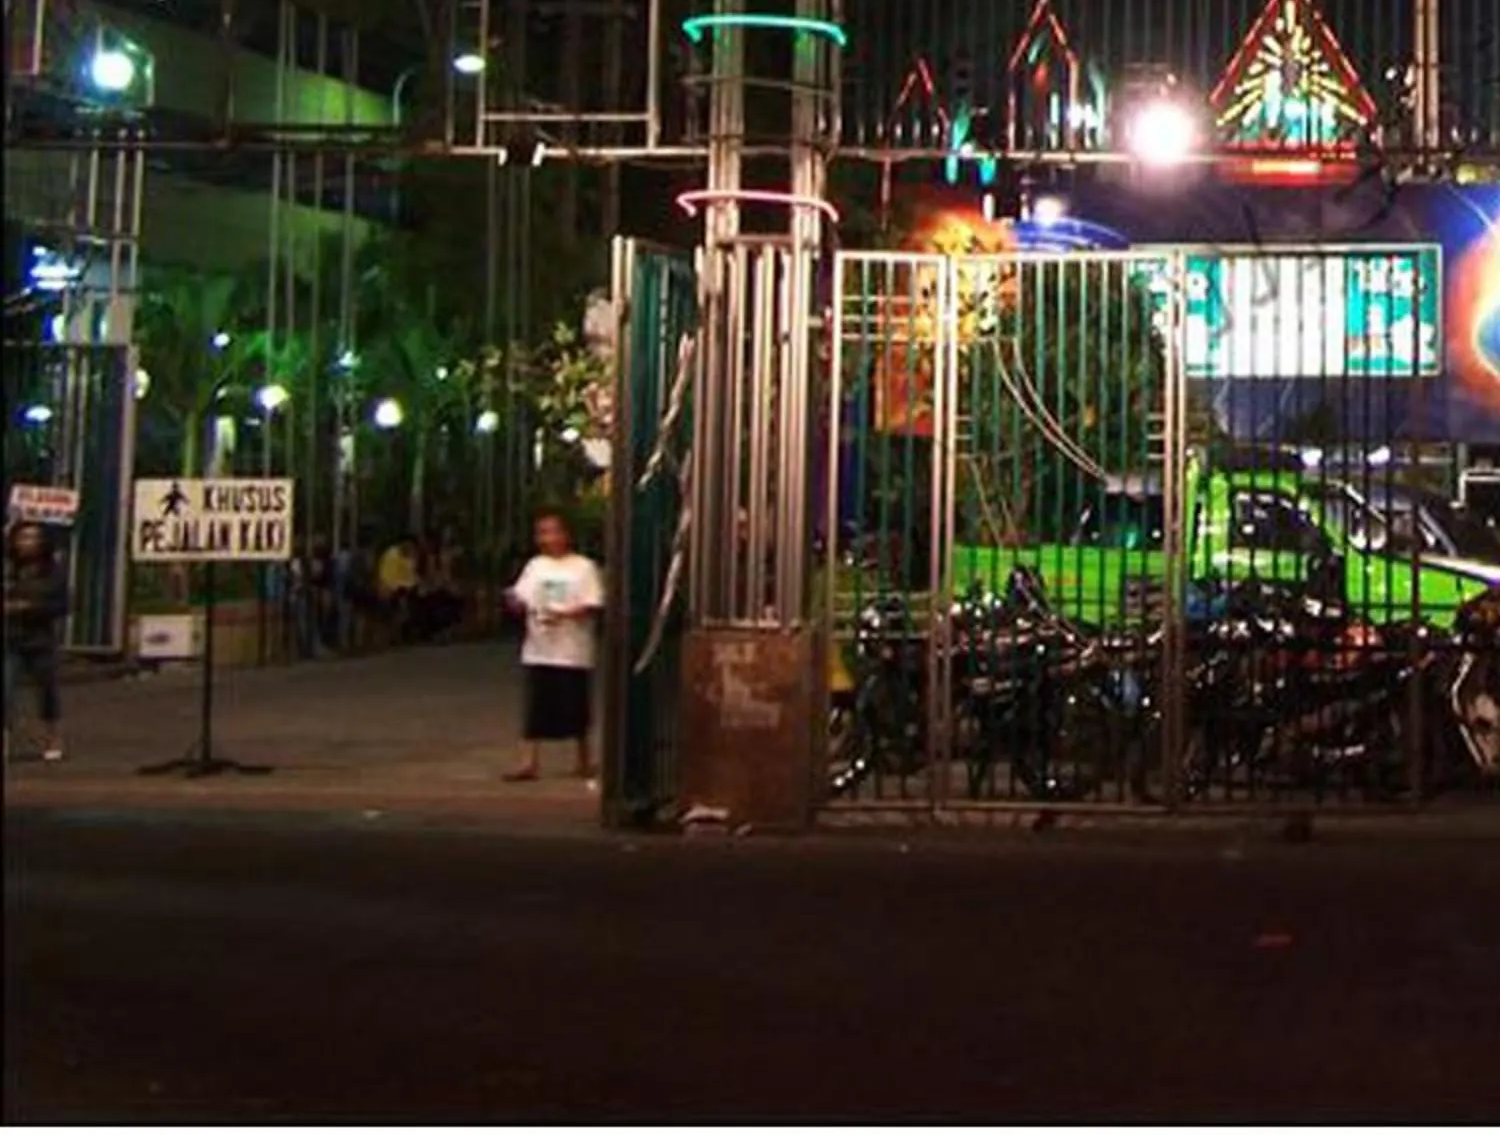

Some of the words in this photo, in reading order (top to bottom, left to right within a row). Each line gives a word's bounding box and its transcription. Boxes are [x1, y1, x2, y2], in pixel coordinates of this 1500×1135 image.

[204, 485, 286, 512] KHUSUS
[141, 519, 233, 552] PEJALAN
[239, 520, 285, 552] KAKI
